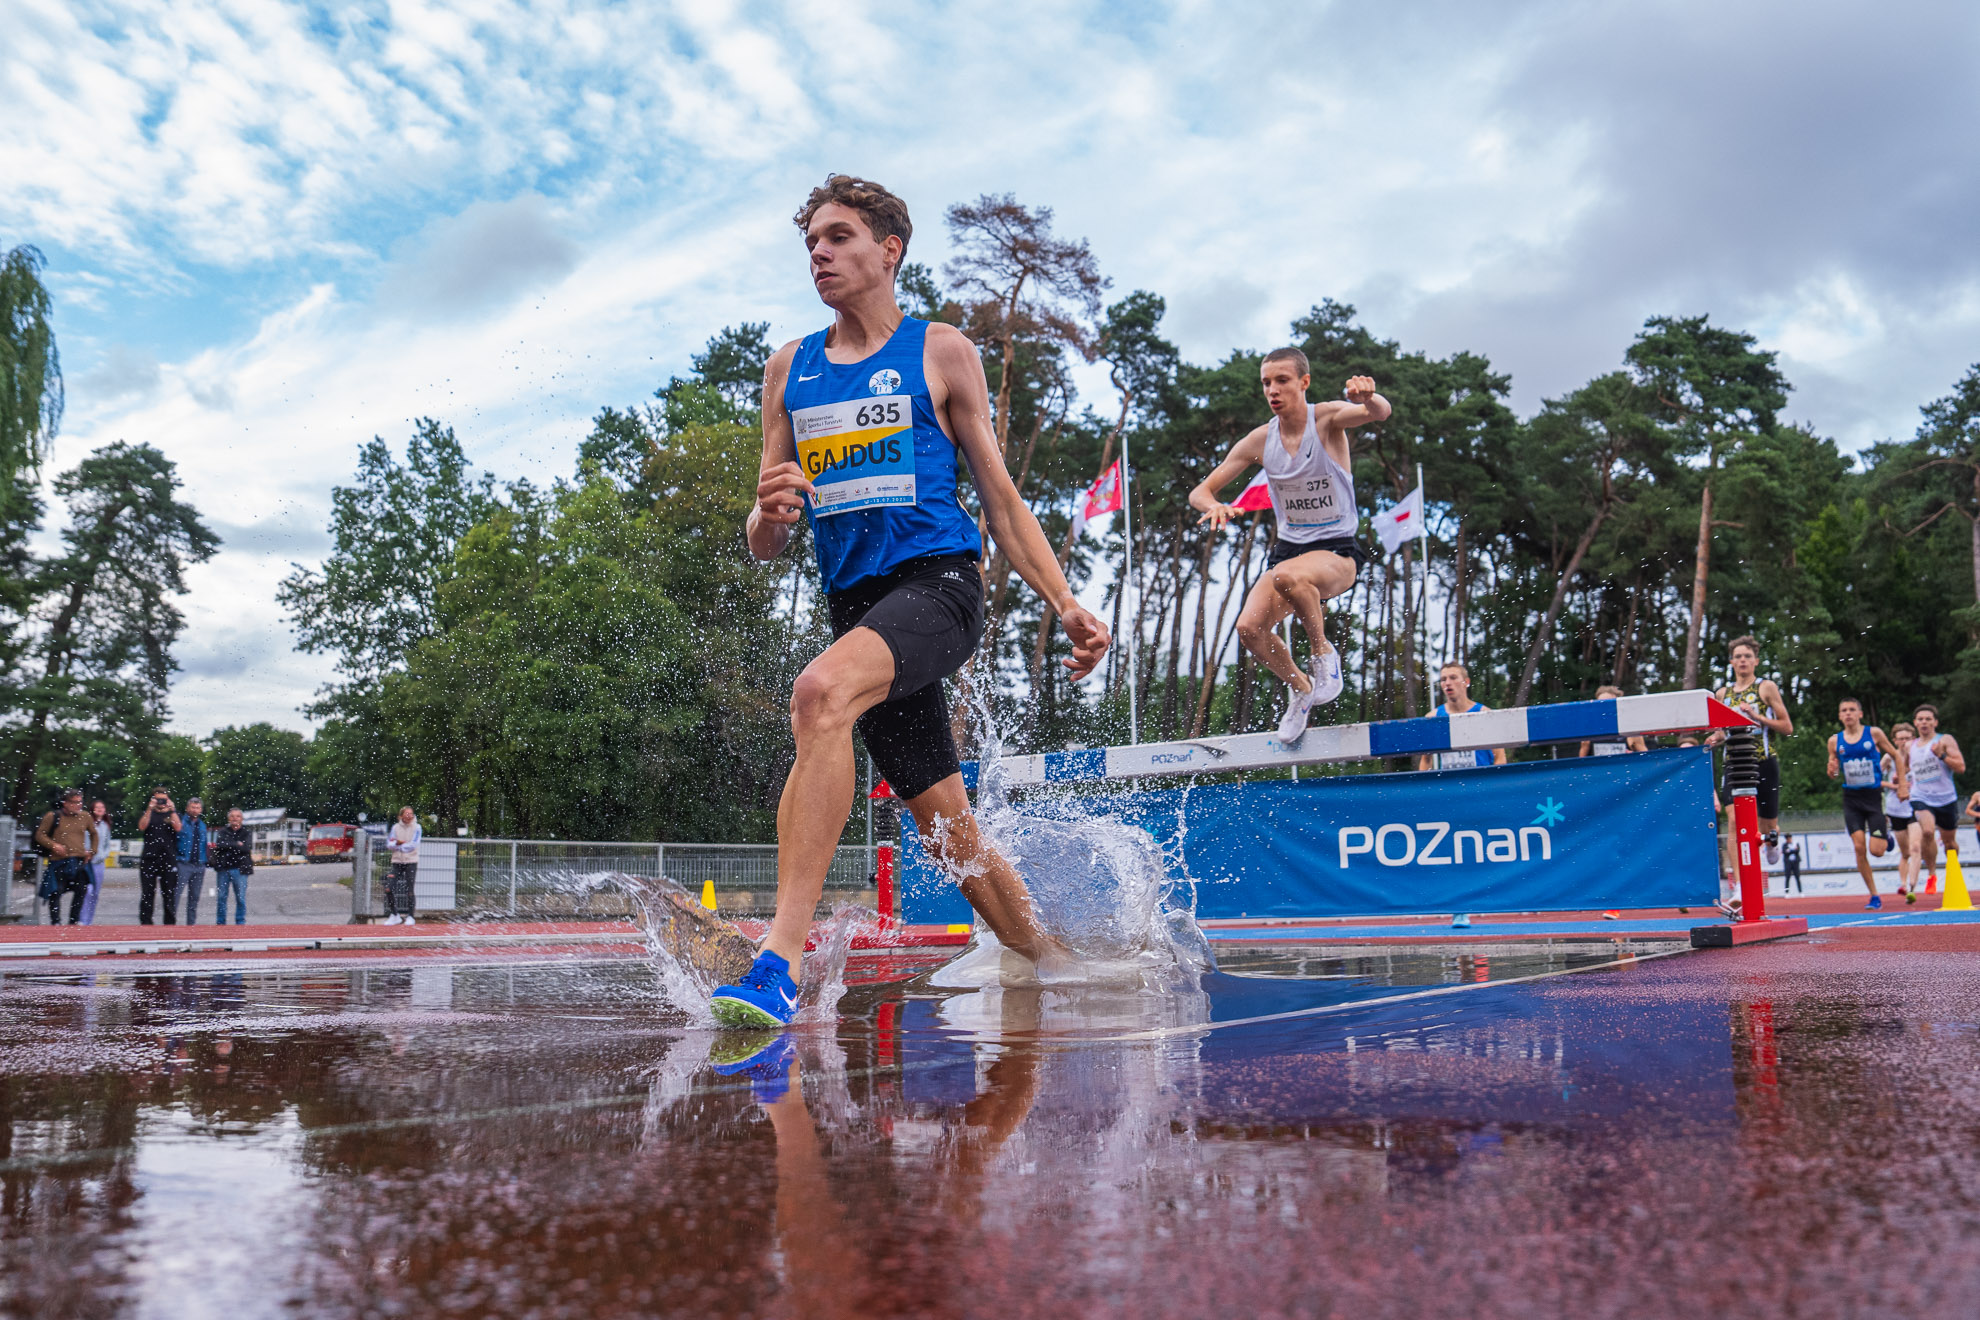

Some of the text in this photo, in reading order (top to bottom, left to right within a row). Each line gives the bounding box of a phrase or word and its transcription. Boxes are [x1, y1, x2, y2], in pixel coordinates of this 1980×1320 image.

[856, 403, 900, 426] 635
[807, 440, 901, 475] GAJDUS
[1307, 480, 1329, 491] 375
[1285, 495, 1333, 510] JARECKI
